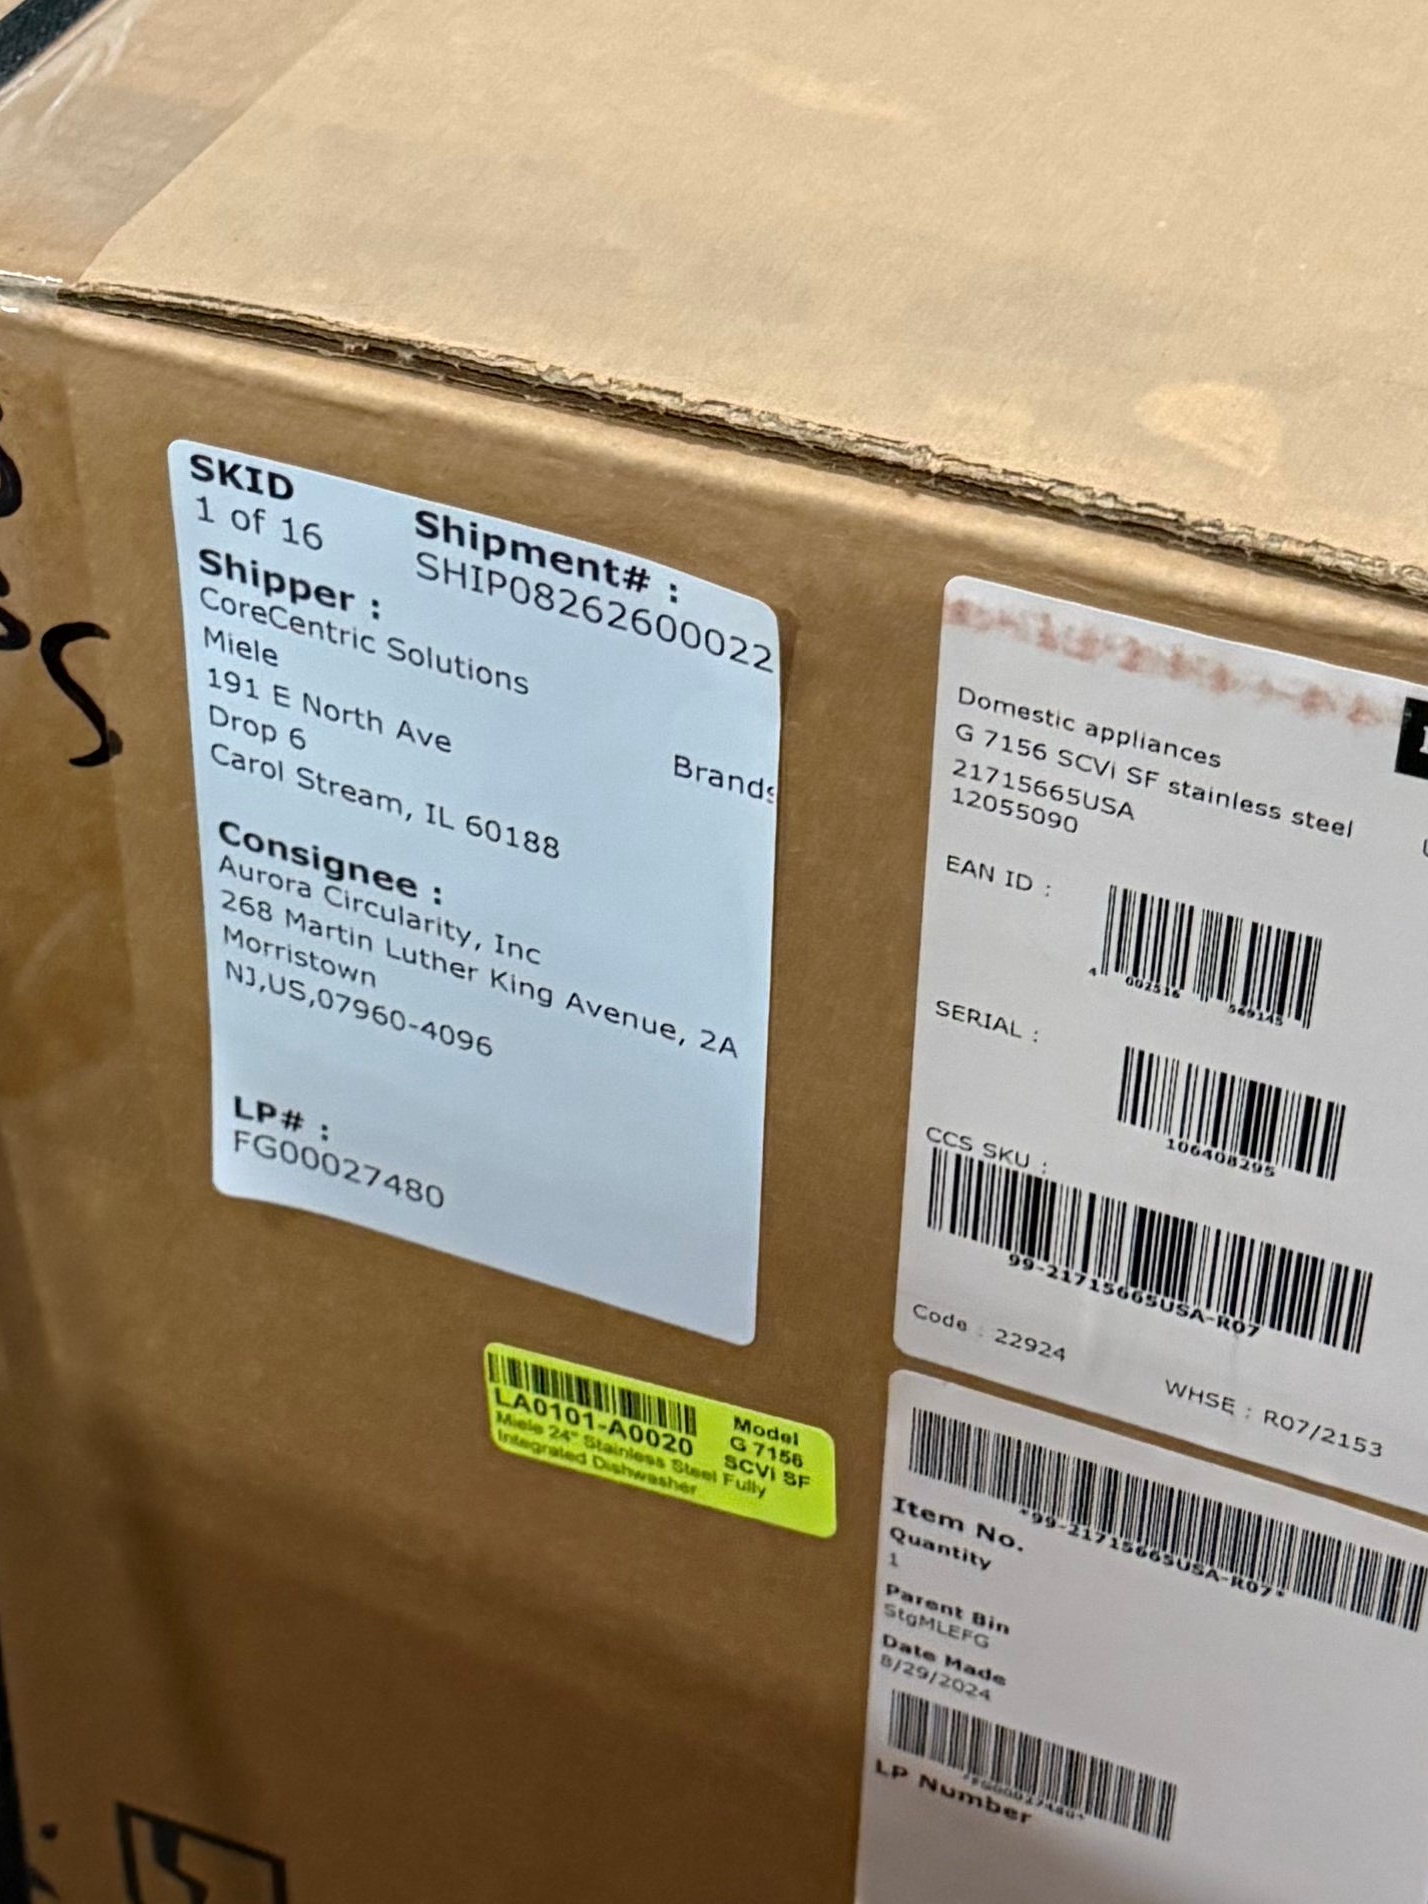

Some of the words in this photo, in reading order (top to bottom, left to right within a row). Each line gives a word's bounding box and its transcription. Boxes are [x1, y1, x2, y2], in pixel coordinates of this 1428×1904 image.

[190, 454, 294, 500] SKID
[196, 496, 215, 526] 1
[231, 508, 266, 535] of
[282, 517, 323, 551] 16
[199, 548, 355, 611] Shipper
[371, 597, 380, 620] :
[415, 510, 650, 593] Shipment#
[669, 581, 678, 604] :
[200, 587, 376, 654] CoreCentric
[387, 637, 529, 695] Solutions
[416, 552, 772, 672] SHIP08262600022
[204, 626, 278, 667] Miele
[208, 668, 259, 700] 191
[273, 684, 290, 708] E
[303, 692, 383, 734] North
[396, 720, 451, 753] Ave
[209, 704, 277, 744] Drop
[289, 727, 306, 750] 6
[958, 686, 1075, 732] Domestic
[1085, 723, 1221, 768] appliances
[211, 743, 283, 782] Carol
[296, 767, 412, 822] Stream,
[426, 802, 455, 830] IL
[466, 815, 560, 859] 60188
[952, 758, 1135, 821] 21715665USA
[952, 787, 1078, 833] 12055090
[955, 723, 973, 742] G
[985, 729, 1047, 761] 7156
[1127, 766, 1159, 788] SF
[1168, 781, 1281, 820] stainless
[1291, 811, 1353, 838] steel
[218, 820, 417, 898] Consignee
[433, 885, 442, 906] :
[946, 854, 995, 883] EAN
[1005, 870, 1033, 891] ID
[1045, 883, 1051, 897] :
[219, 855, 311, 898] Aurora
[324, 886, 481, 951] Circularity,
[495, 933, 541, 965] Inc
[222, 889, 273, 922] 268
[285, 908, 373, 952] Martin
[386, 938, 479, 982] Luther
[491, 968, 553, 1008] King
[565, 992, 685, 1047] Avenue,
[700, 1029, 738, 1059] 2A
[224, 925, 376, 988] Morristown
[1125, 975, 1181, 998] 002516
[226, 960, 493, 1057] NJ,US,07960-4096
[936, 1000, 1022, 1039] SERIAL
[1033, 1030, 1039, 1043] :
[234, 1095, 304, 1132] LP#
[321, 1122, 329, 1142] :
[234, 1130, 444, 1209] FG00027480
[926, 1126, 973, 1151] CCS
[983, 1142, 1030, 1167] SKU
[1043, 1161, 1046, 1173] :
[913, 1304, 967, 1332] Code
[994, 1328, 1065, 1362] 22924
[495, 1389, 693, 1455] LA0101-A0020
[734, 1416, 798, 1446] Model
[1165, 1379, 1236, 1416] WHSE
[1245, 1407, 1251, 1419] :
[1264, 1409, 1383, 1457] R07/2153
[498, 1412, 543, 1434] Miele
[584, 1433, 667, 1469] Stainless
[672, 1459, 717, 1483] Steel
[723, 1473, 766, 1499] Fully
[498, 1429, 586, 1465] Integrated
[593, 1452, 696, 1495] Dishwasher
[730, 1436, 746, 1452] G
[754, 1442, 803, 1468] 7156
[783, 1471, 810, 1489] SF
[890, 1527, 992, 1571] Quantity
[893, 1497, 964, 1532] Item
[976, 1522, 1024, 1553] No.
[888, 1553, 898, 1567] 1
[887, 1584, 963, 1620] Parent
[972, 1612, 1010, 1635] Bin
[880, 1655, 992, 1701] 8/29/2024
[883, 1634, 936, 1662] Date
[945, 1655, 1006, 1686] Made
[876, 1759, 909, 1780] LP
[918, 1774, 1031, 1824] Number
